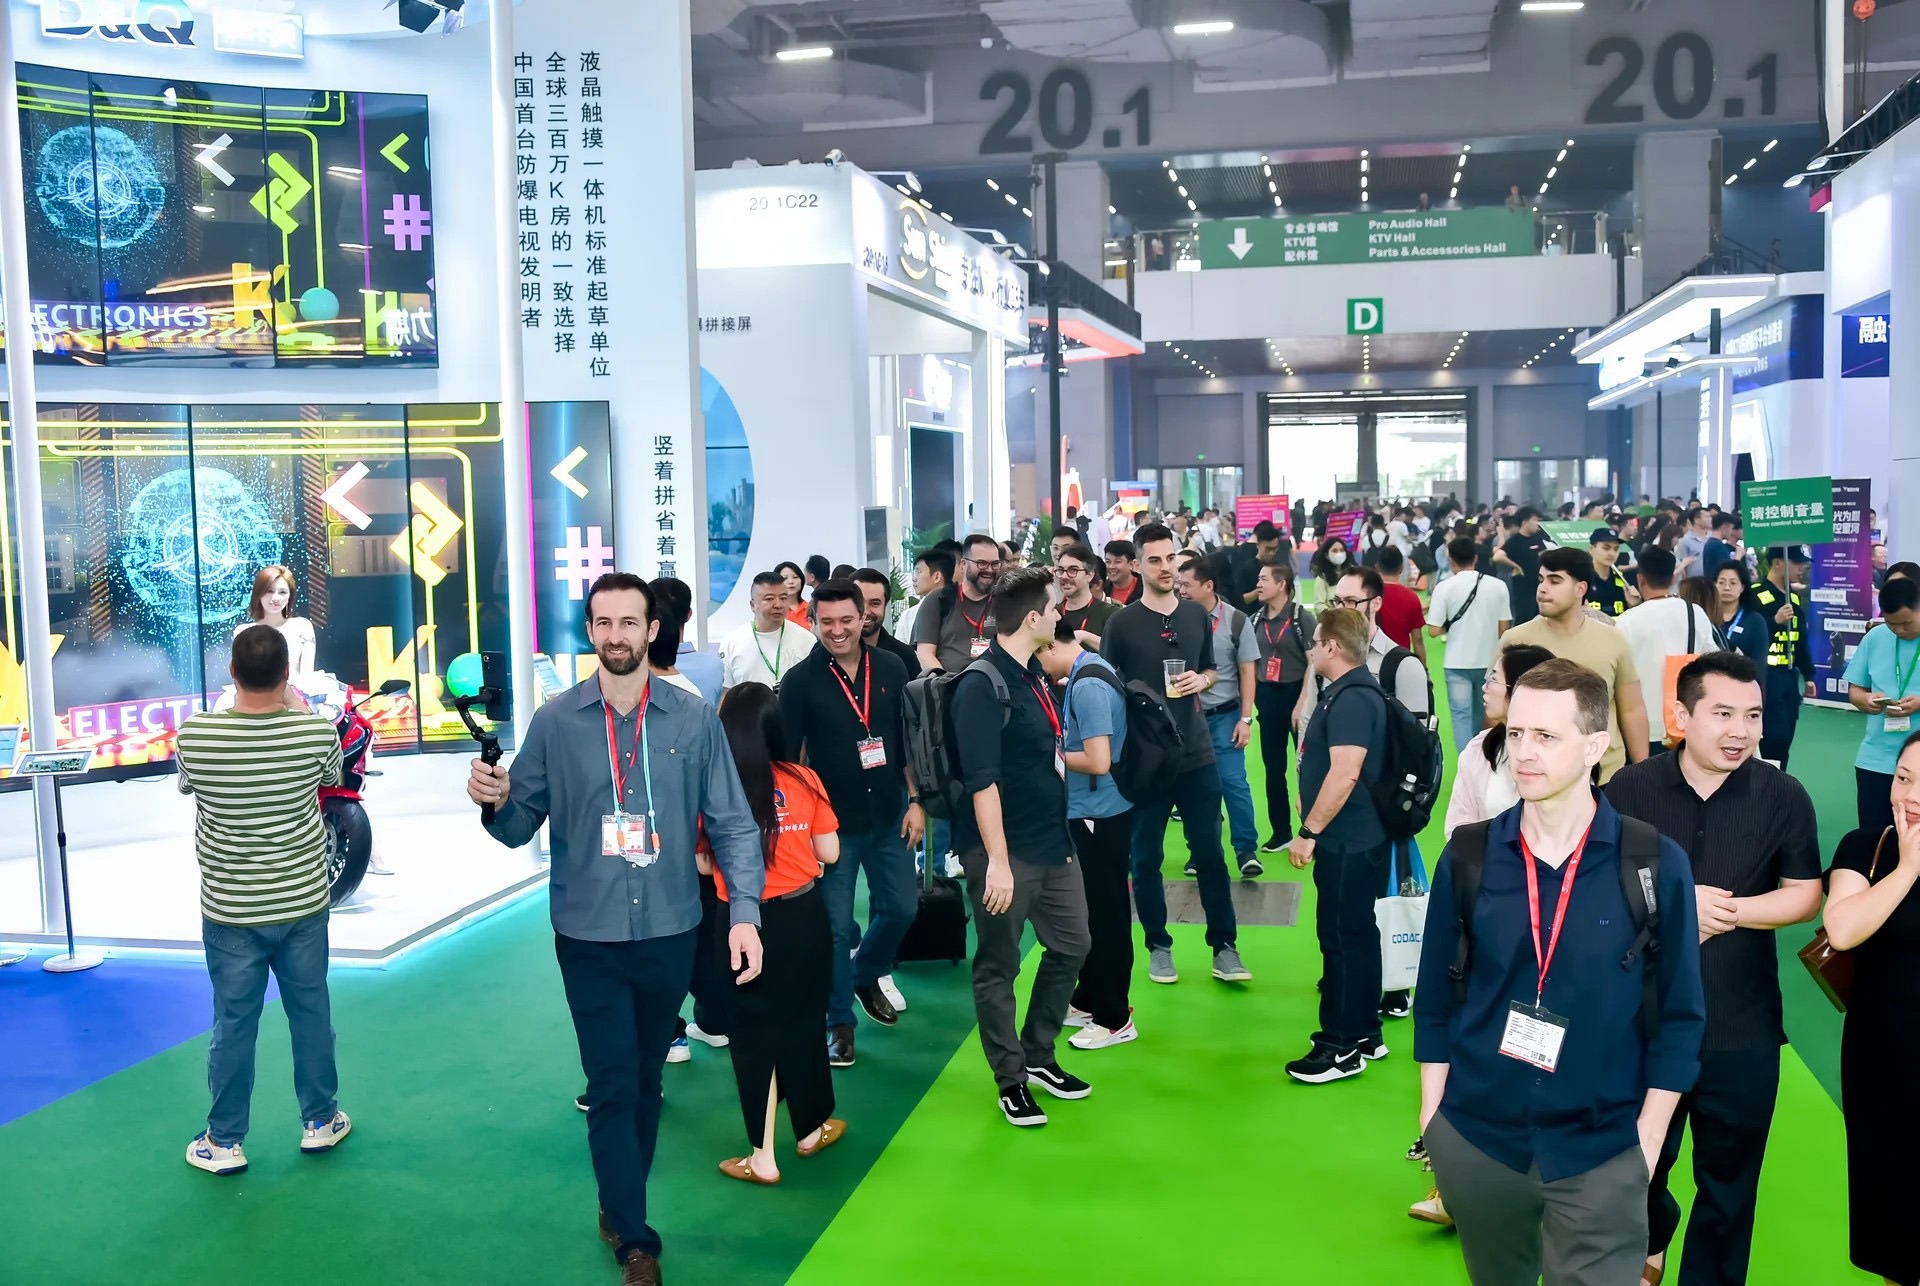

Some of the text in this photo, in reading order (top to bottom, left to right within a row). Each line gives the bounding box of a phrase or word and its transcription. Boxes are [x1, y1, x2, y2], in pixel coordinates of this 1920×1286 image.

[1585, 33, 1777, 123] 20.1
[979, 67, 1153, 154] 20.1
[514, 52, 542, 328] 中国首台防爆电视发明者
[545, 51, 575, 353] 全球三百万K房的一致选择
[749, 194, 819, 211] 201C22
[580, 51, 610, 377] 液晶触摸一体机标准起草单位
[1368, 217, 1447, 230] Pro Audio Hall
[1368, 232, 1416, 244] KTV Hall
[1368, 242, 1507, 258] Parts & Accessories Hall
[1354, 302, 1378, 330] D
[1750, 502, 1824, 520] 请控制音量
